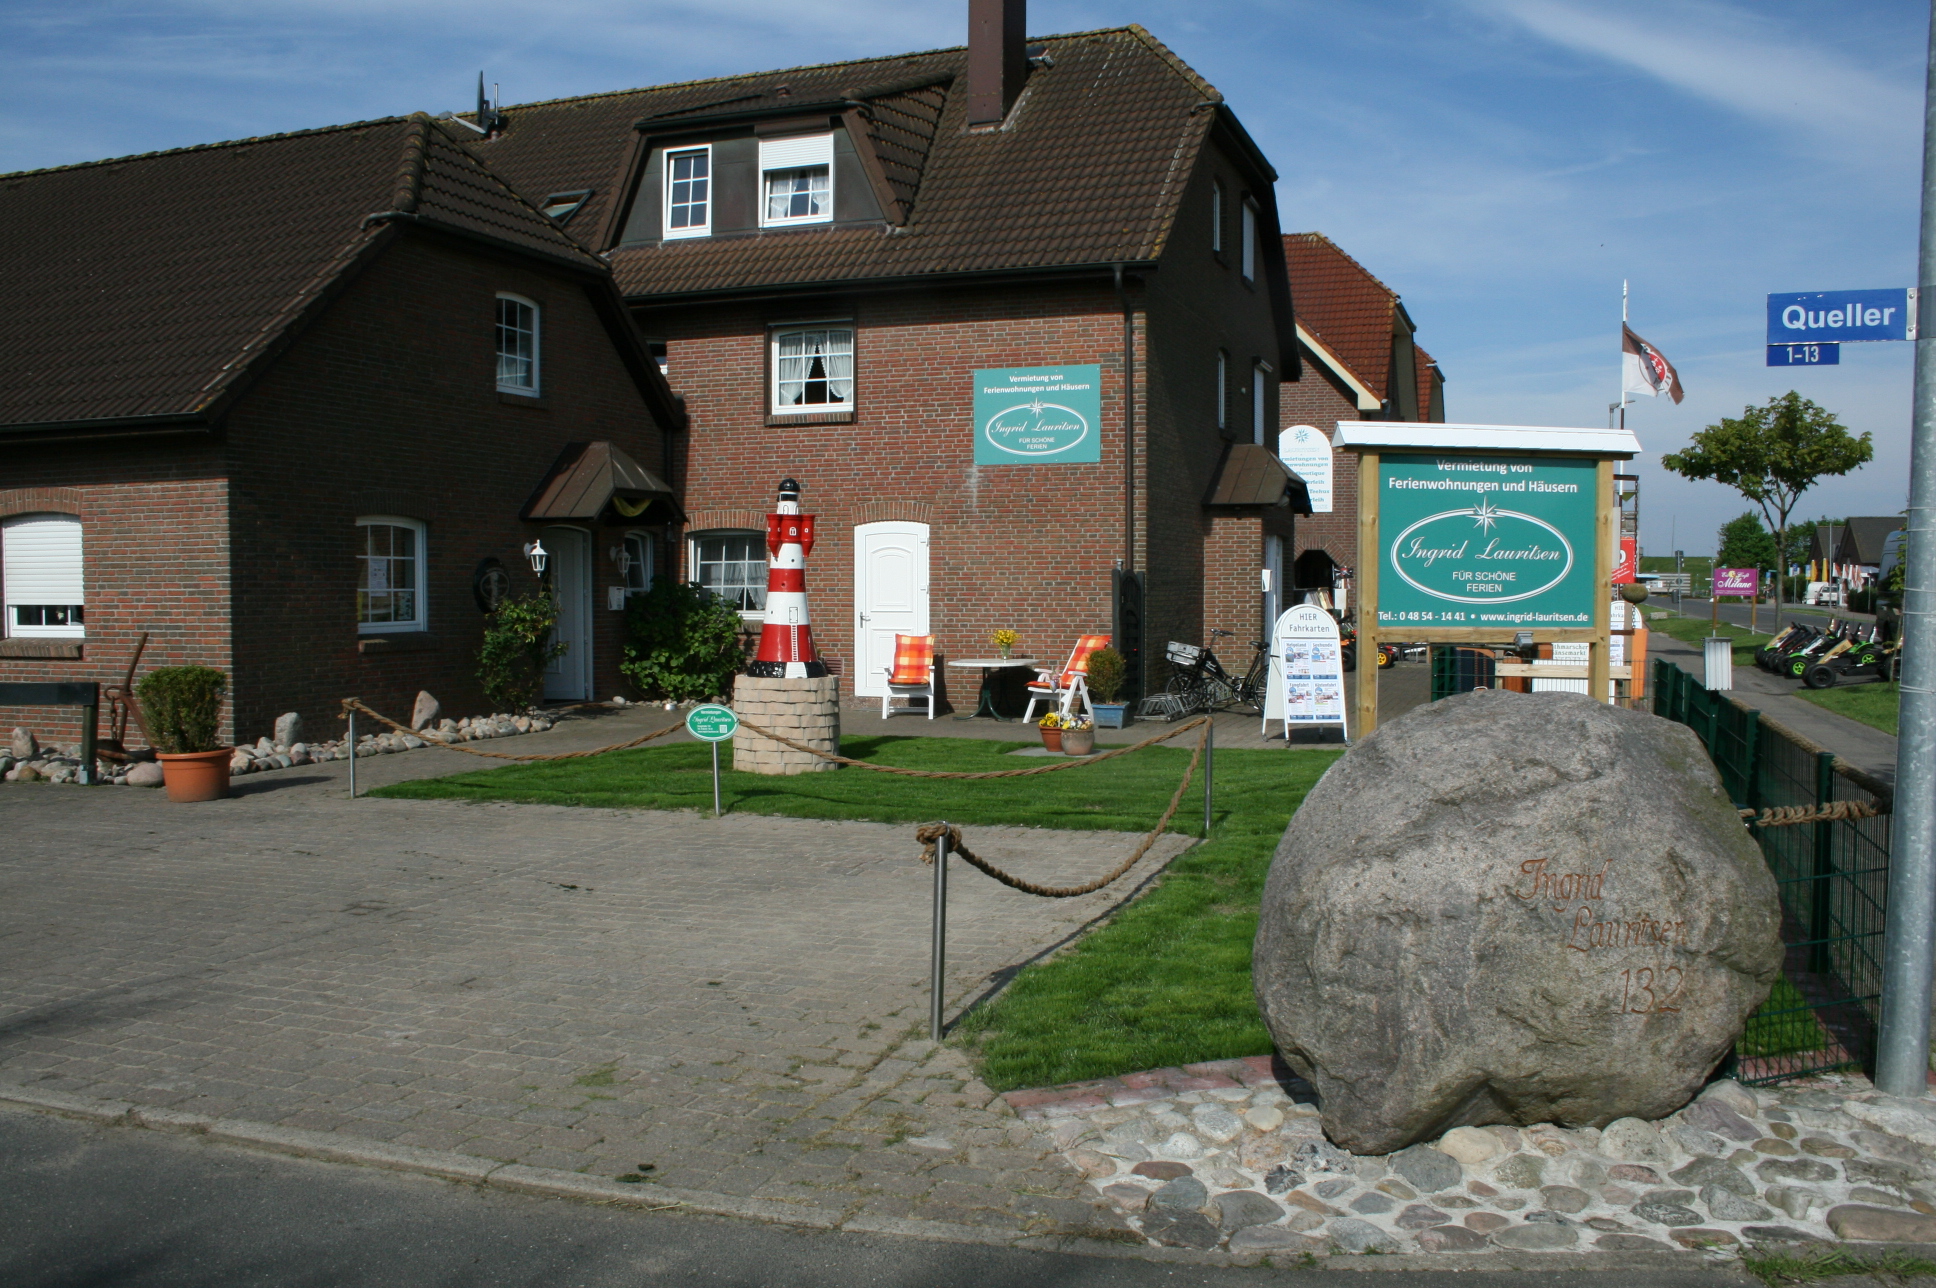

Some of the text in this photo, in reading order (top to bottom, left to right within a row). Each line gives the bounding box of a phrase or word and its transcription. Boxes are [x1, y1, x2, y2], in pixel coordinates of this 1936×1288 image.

[1782, 303, 1896, 331] Queller
[1786, 346, 1819, 363] 1-13
[1009, 375, 1049, 383] Vermietung
[984, 385, 1045, 394] Ferienwohnungen
[1061, 383, 1090, 391] Häusern
[991, 419, 1080, 437] Ingrid Lauritsen
[1436, 459, 1533, 475] Vermietung von
[1389, 477, 1578, 493] Ferienwohnungen und Häusern
[1401, 536, 1561, 567] Ingrid Lauritsen
[1452, 570, 1516, 581] FÜR SCHÖNE
[1466, 583, 1502, 592] FERIEN
[1299, 613, 1318, 621] HIER
[1378, 611, 1398, 621] Tel.:
[1400, 612, 1406, 621] 0
[1408, 612, 1420, 621] 48
[1421, 612, 1433, 621] 54
[1441, 612, 1453, 621] 14
[1454, 612, 1465, 621] 41
[1480, 611, 1589, 623] www.ingrid-lauritsen.de
[1289, 624, 1330, 632] Fahrkarten
[1516, 857, 1613, 913] Ingrid
[1566, 905, 1689, 953] Lauritsen
[1620, 966, 1684, 1014] 132
